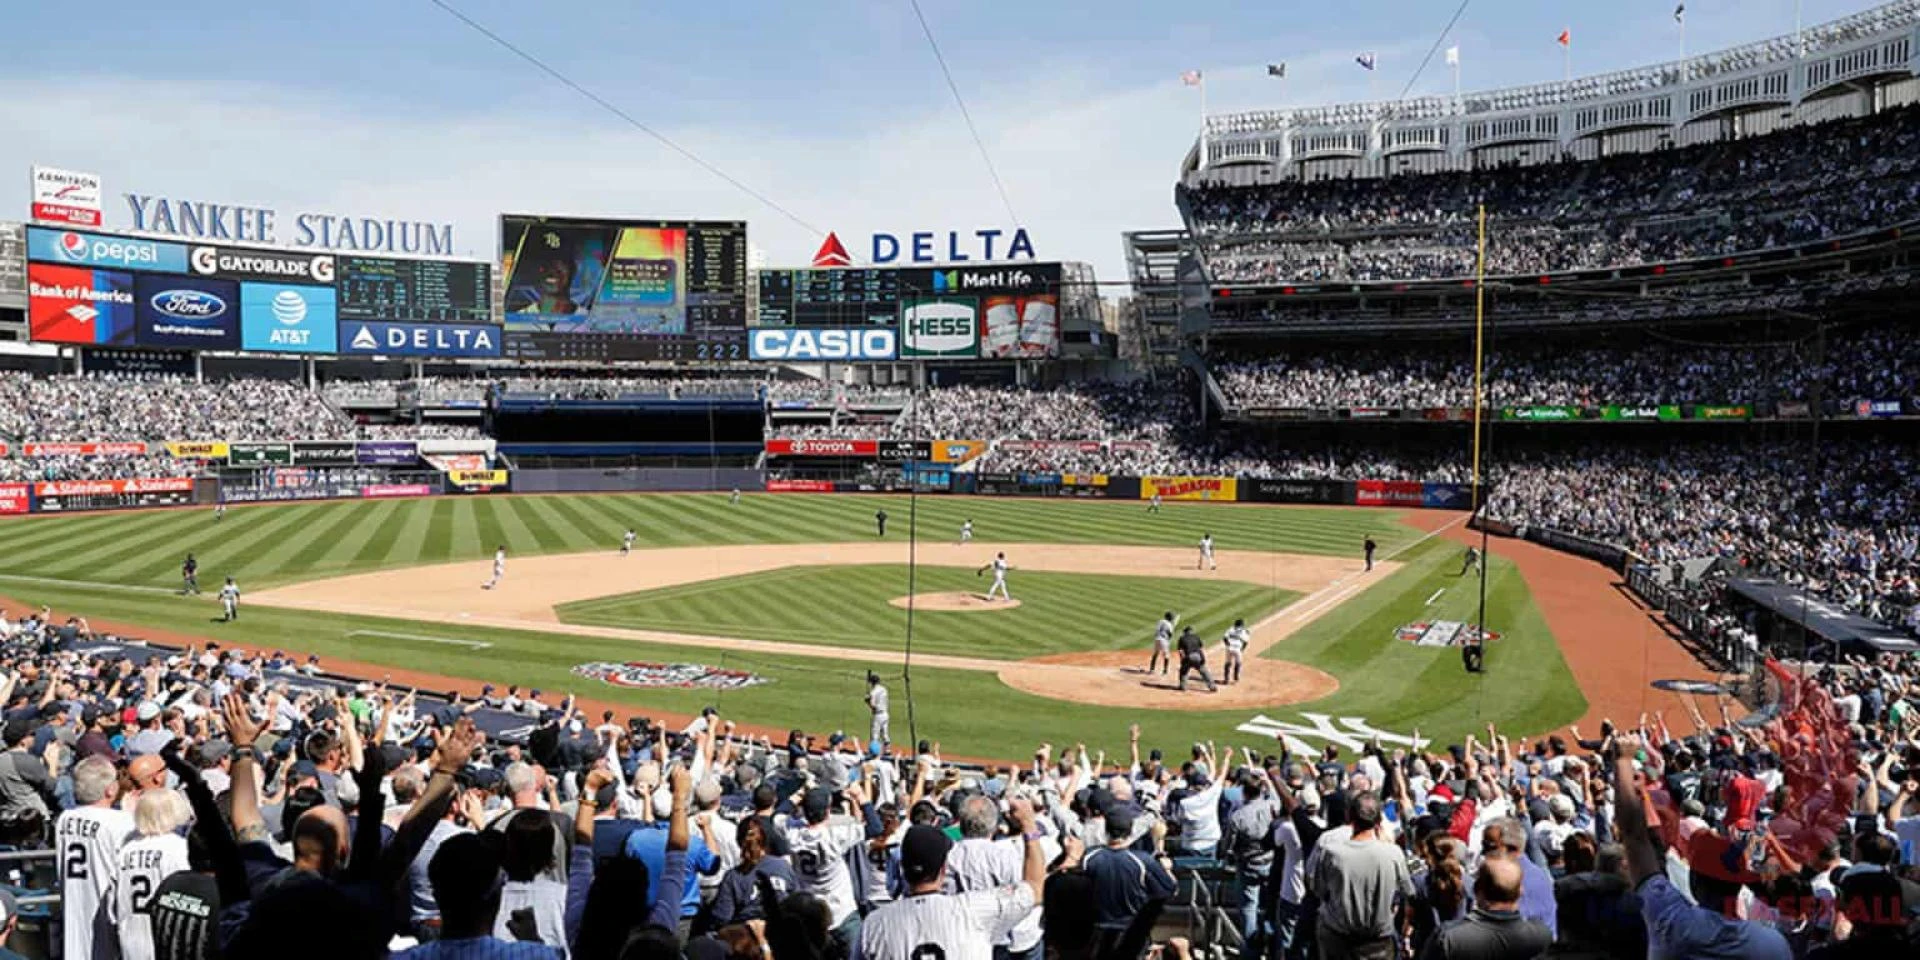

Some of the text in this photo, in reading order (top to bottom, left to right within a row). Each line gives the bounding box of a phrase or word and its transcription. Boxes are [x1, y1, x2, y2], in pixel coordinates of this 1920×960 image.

[122, 194, 456, 257] YANKEE STADIUM
[93, 240, 158, 265] pepsi
[872, 228, 1035, 263] DELTA
[192, 248, 334, 282] G GATORADE G
[962, 271, 1031, 289] MetLife
[29, 282, 133, 303] Bank of America
[165, 293, 211, 314] Ford
[269, 329, 311, 345] AT&T
[909, 317, 971, 336] HESS
[387, 327, 492, 349] DELTA
[754, 329, 895, 359] CASIO
[697, 344, 708, 359] 2
[713, 344, 724, 359] 2
[729, 344, 740, 359] 2
[808, 442, 855, 452] TOYOTA
[881, 450, 928, 458] COACH
[60, 818, 100, 839] JETER
[67, 842, 88, 880] 2
[121, 849, 162, 870] JETER
[130, 874, 153, 915] 2
